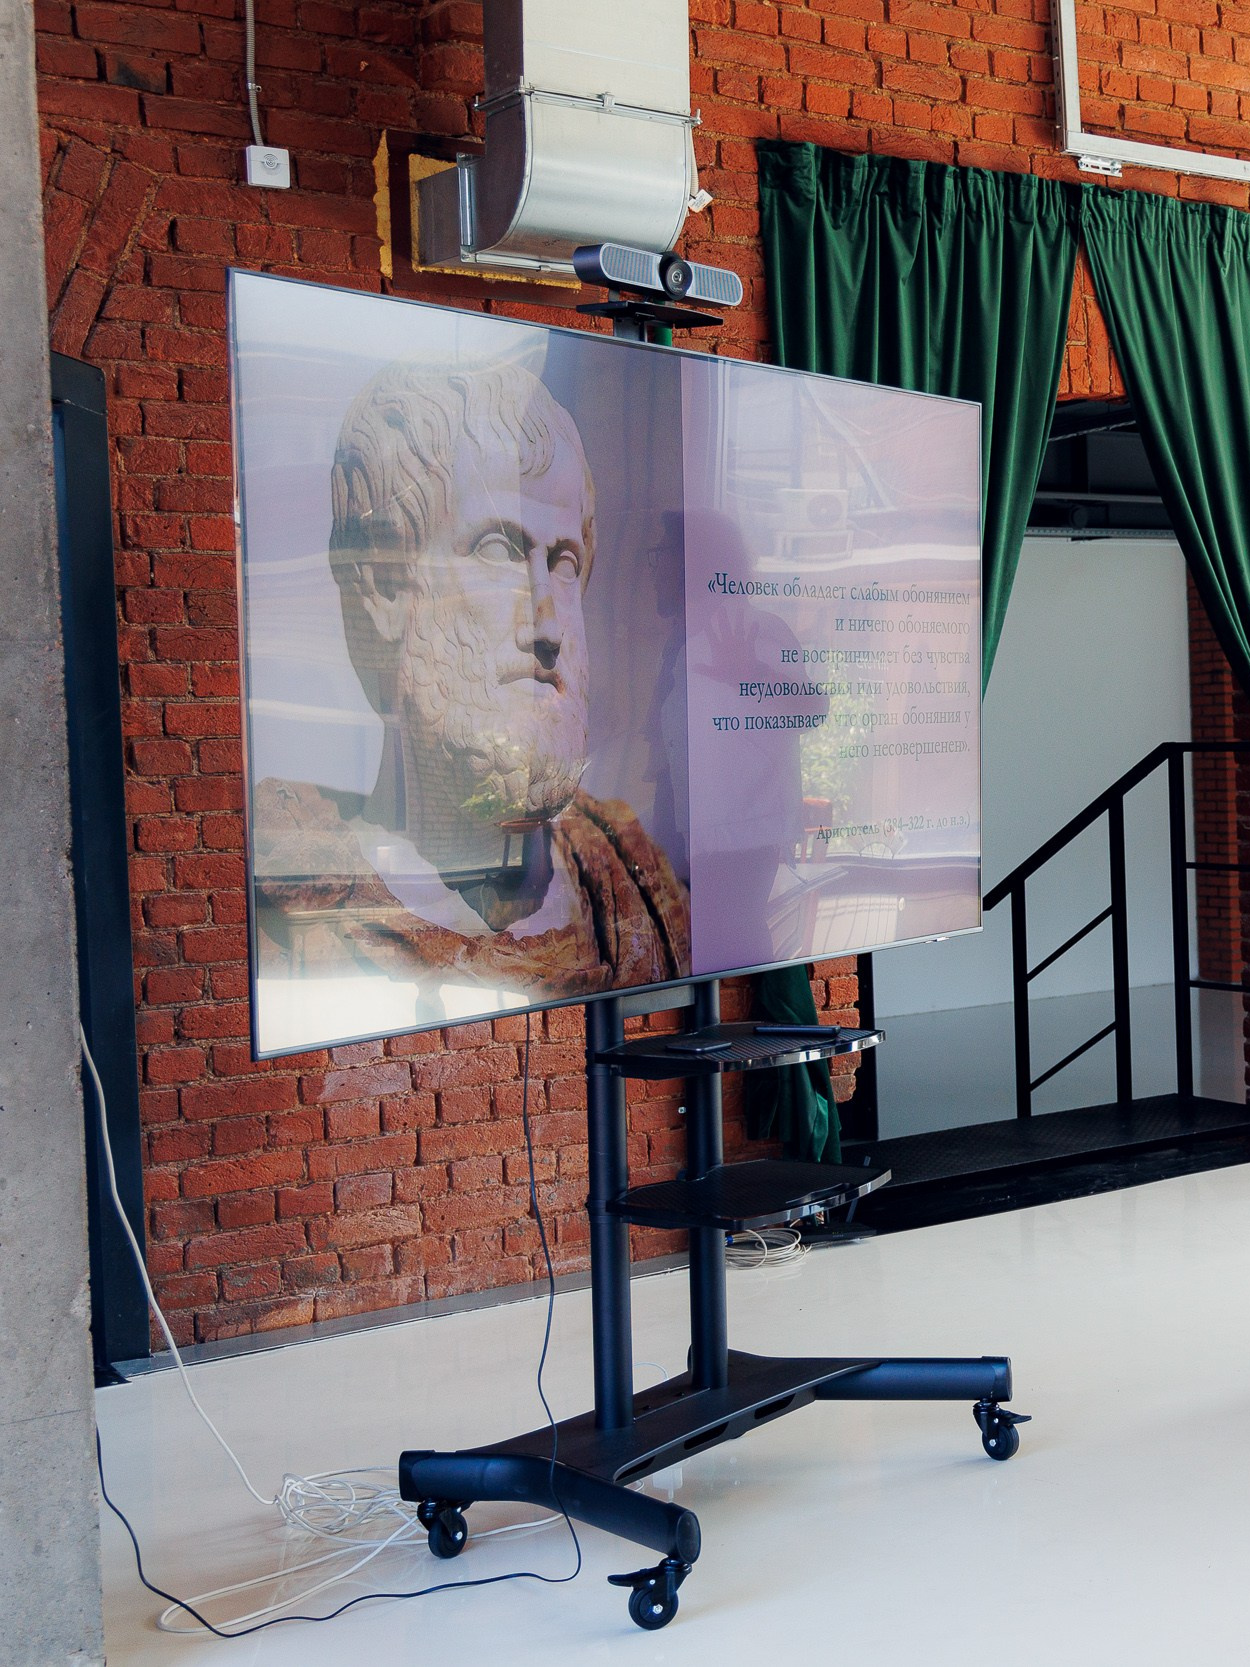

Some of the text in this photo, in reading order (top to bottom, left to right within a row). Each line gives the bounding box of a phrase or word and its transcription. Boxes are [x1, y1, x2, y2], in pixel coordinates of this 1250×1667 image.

[708, 572, 971, 605] «Человек обладает слабым обонянием
[835, 614, 971, 635] и ничего обоняемого
[781, 645, 971, 671] не воспринимает без чувства
[739, 681, 971, 704] неудовольствия или удовольствия,
[712, 716, 740, 731] что
[834, 712, 857, 728] что
[862, 712, 898, 733] орган
[902, 705, 961, 725] обоняния
[964, 711, 971, 729] у
[839, 744, 869, 759] него
[816, 824, 880, 844] Аристотель
